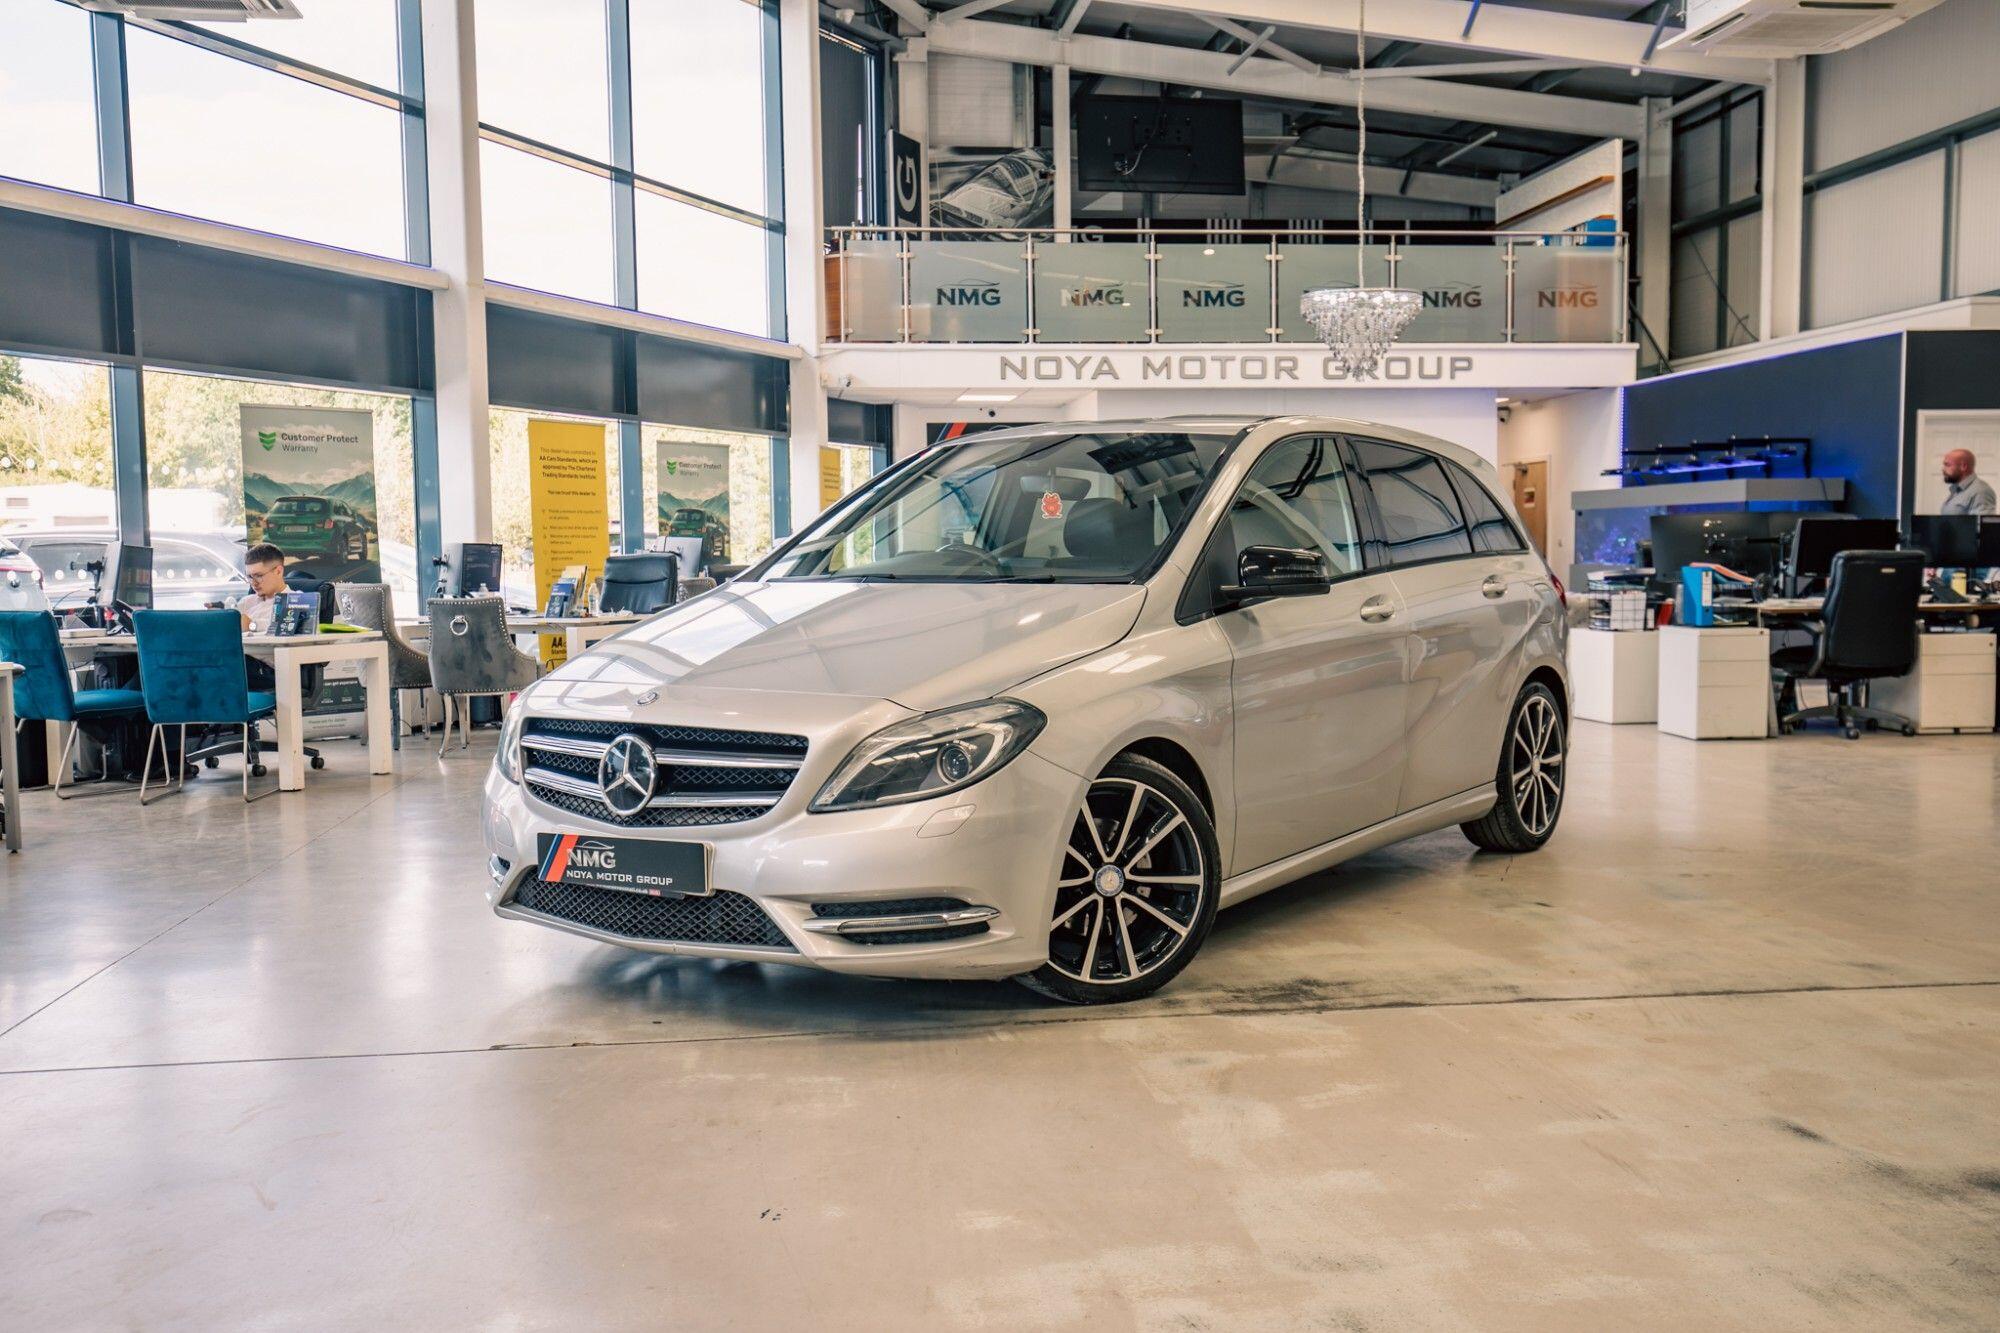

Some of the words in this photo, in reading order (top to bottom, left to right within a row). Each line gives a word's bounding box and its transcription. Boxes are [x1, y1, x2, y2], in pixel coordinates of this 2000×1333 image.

[936, 287, 1002, 307] NMG
[1060, 288, 1125, 307] NMG
[1183, 289, 1246, 308] NMG
[1422, 290, 1482, 309] NMG
[1537, 291, 1598, 309] NMG
[1000, 355, 1120, 381] NOYA
[1142, 355, 1300, 381] MOTOR
[281, 432, 325, 443] Customer
[326, 434, 359, 444] Protect
[282, 444, 319, 454] Warranty
[679, 461, 703, 469] Customer
[703, 462, 722, 470] Protect
[552, 637, 562, 647] AA
[566, 849, 616, 869] NMG
[566, 870, 593, 880] NOYA
[596, 872, 633, 883] MOTOR
[636, 875, 673, 886] GROUP
